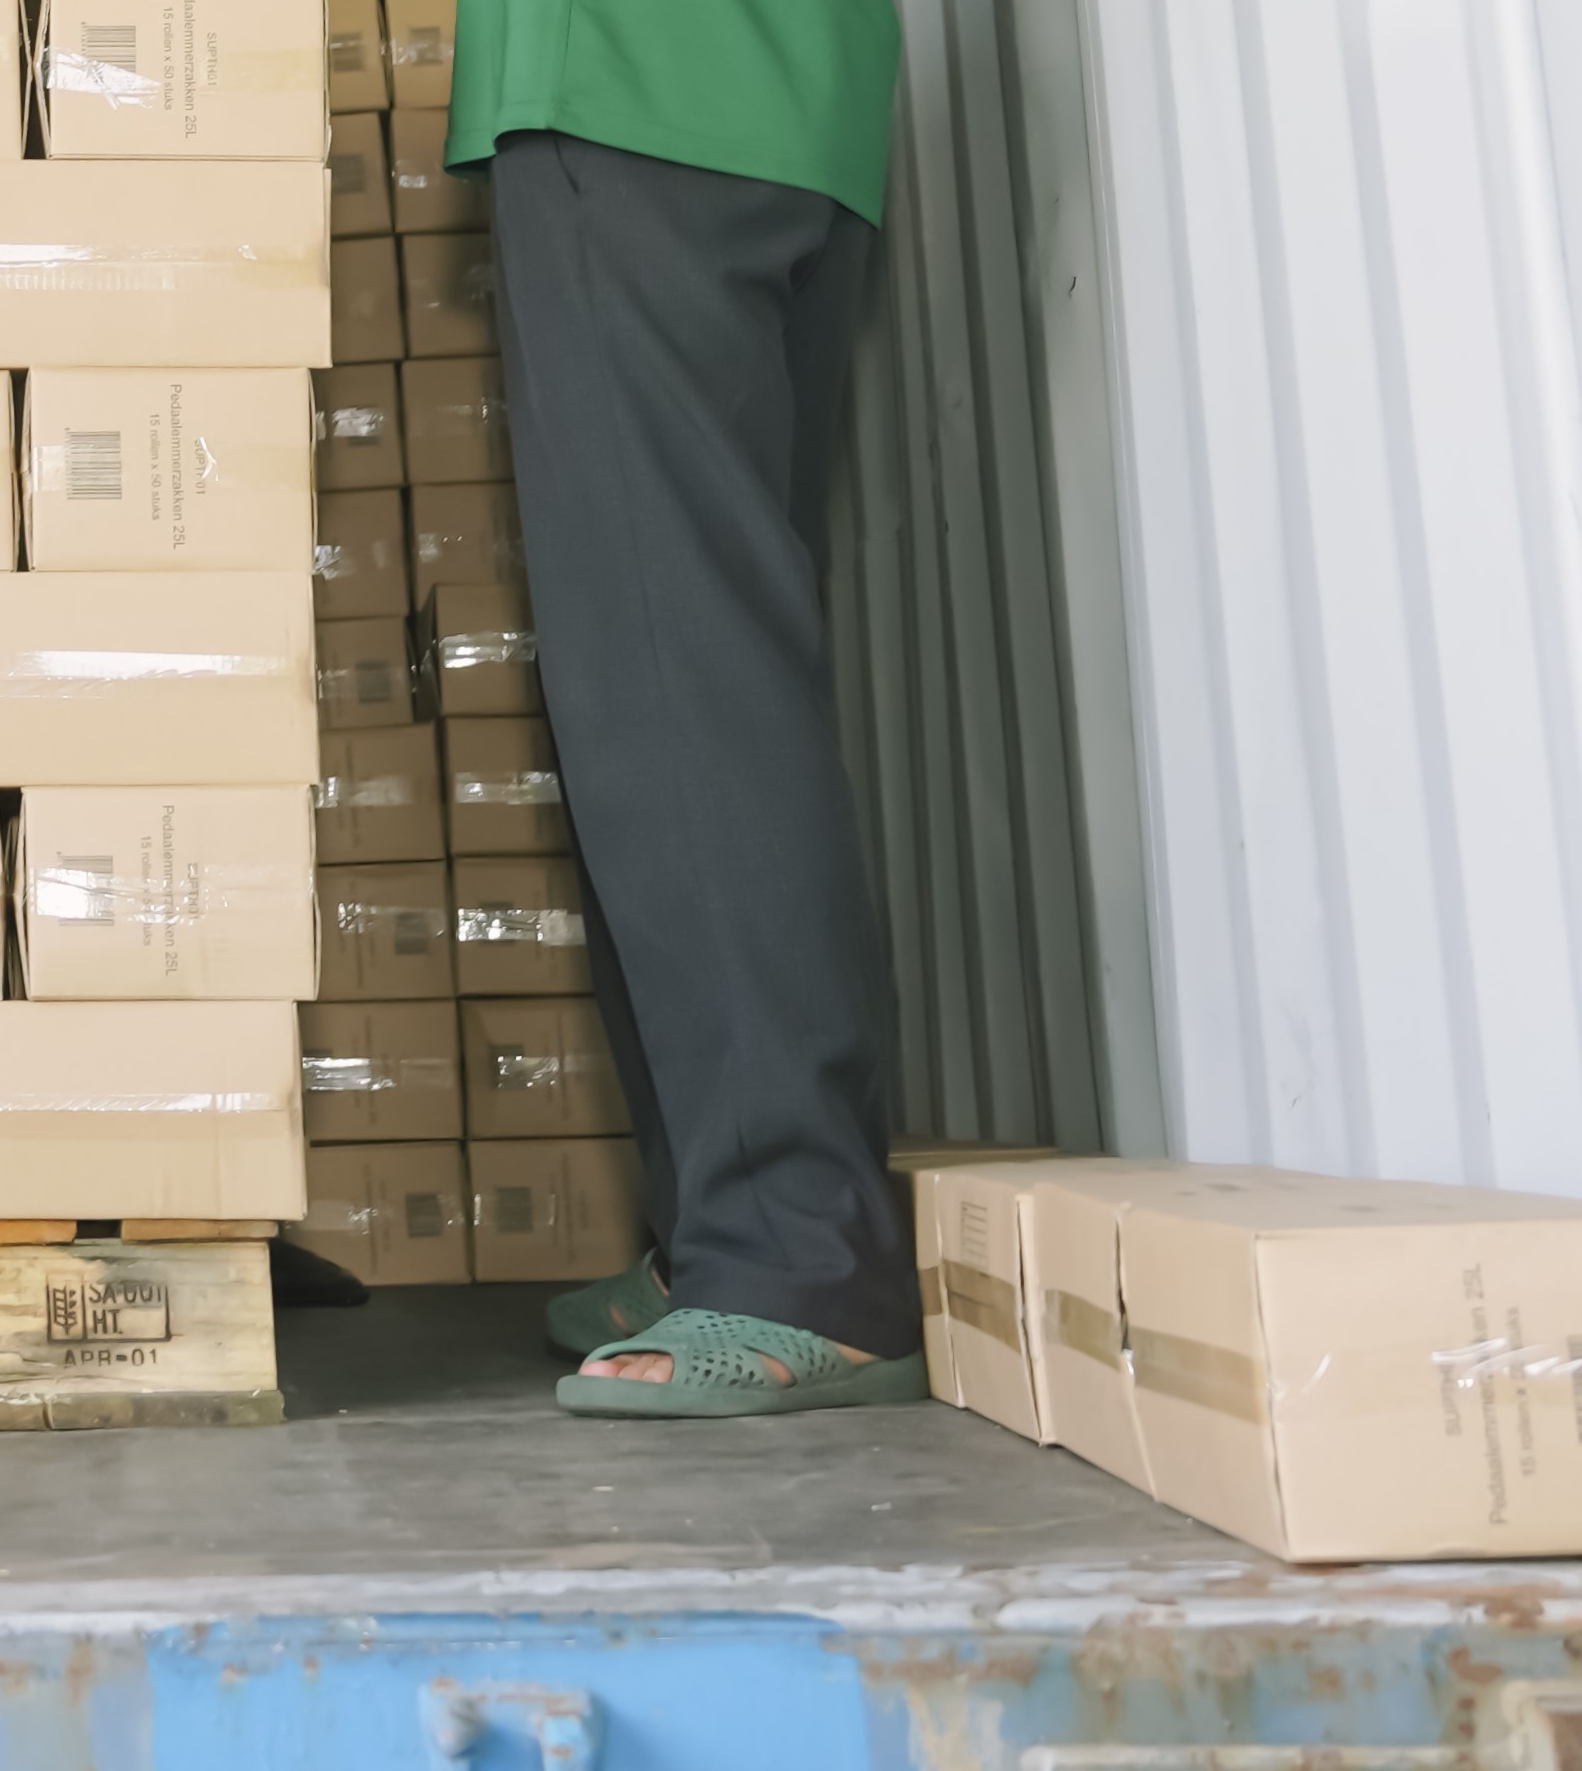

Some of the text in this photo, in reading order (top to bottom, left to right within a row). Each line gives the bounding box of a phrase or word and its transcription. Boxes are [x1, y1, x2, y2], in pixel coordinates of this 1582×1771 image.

[163, 6, 173, 112] 15 rollen 50 stuks
[207, 32, 217, 86] SUPTH01
[185, 115, 196, 139] 25L
[150, 413, 161, 521] 15 rollen 50 stuks
[171, 384, 185, 550] Pedaalemmerzakken 25L
[141, 836, 151, 850] 15
[165, 951, 177, 978] 25L
